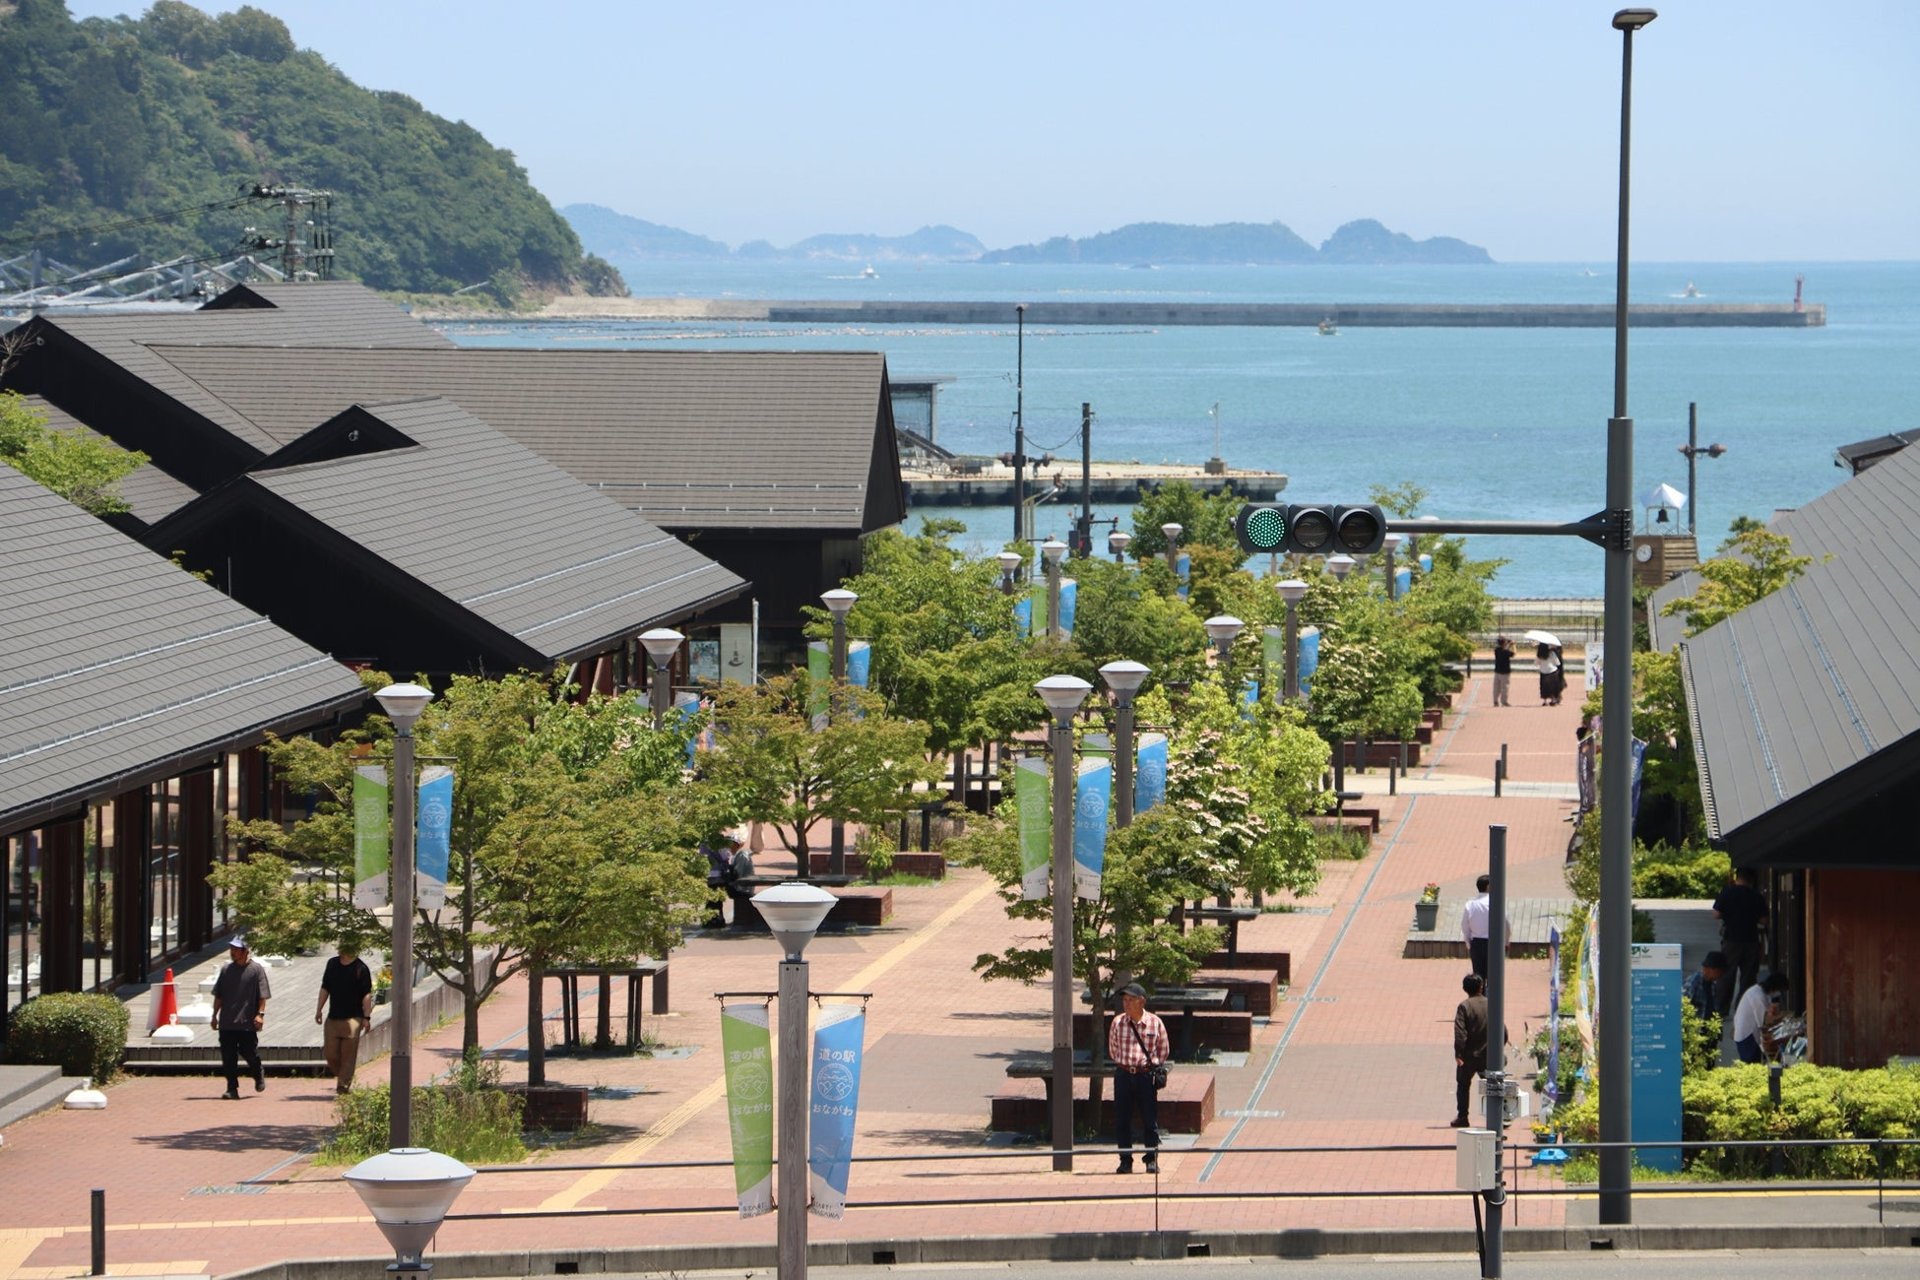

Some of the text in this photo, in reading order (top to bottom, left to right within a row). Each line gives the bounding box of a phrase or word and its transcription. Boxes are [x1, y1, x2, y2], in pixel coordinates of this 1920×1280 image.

[729, 1047, 765, 1063] 道の駅
[818, 1048, 856, 1064] 道の駅
[732, 1102, 772, 1116] おながわ
[813, 1103, 854, 1117] おながわ
